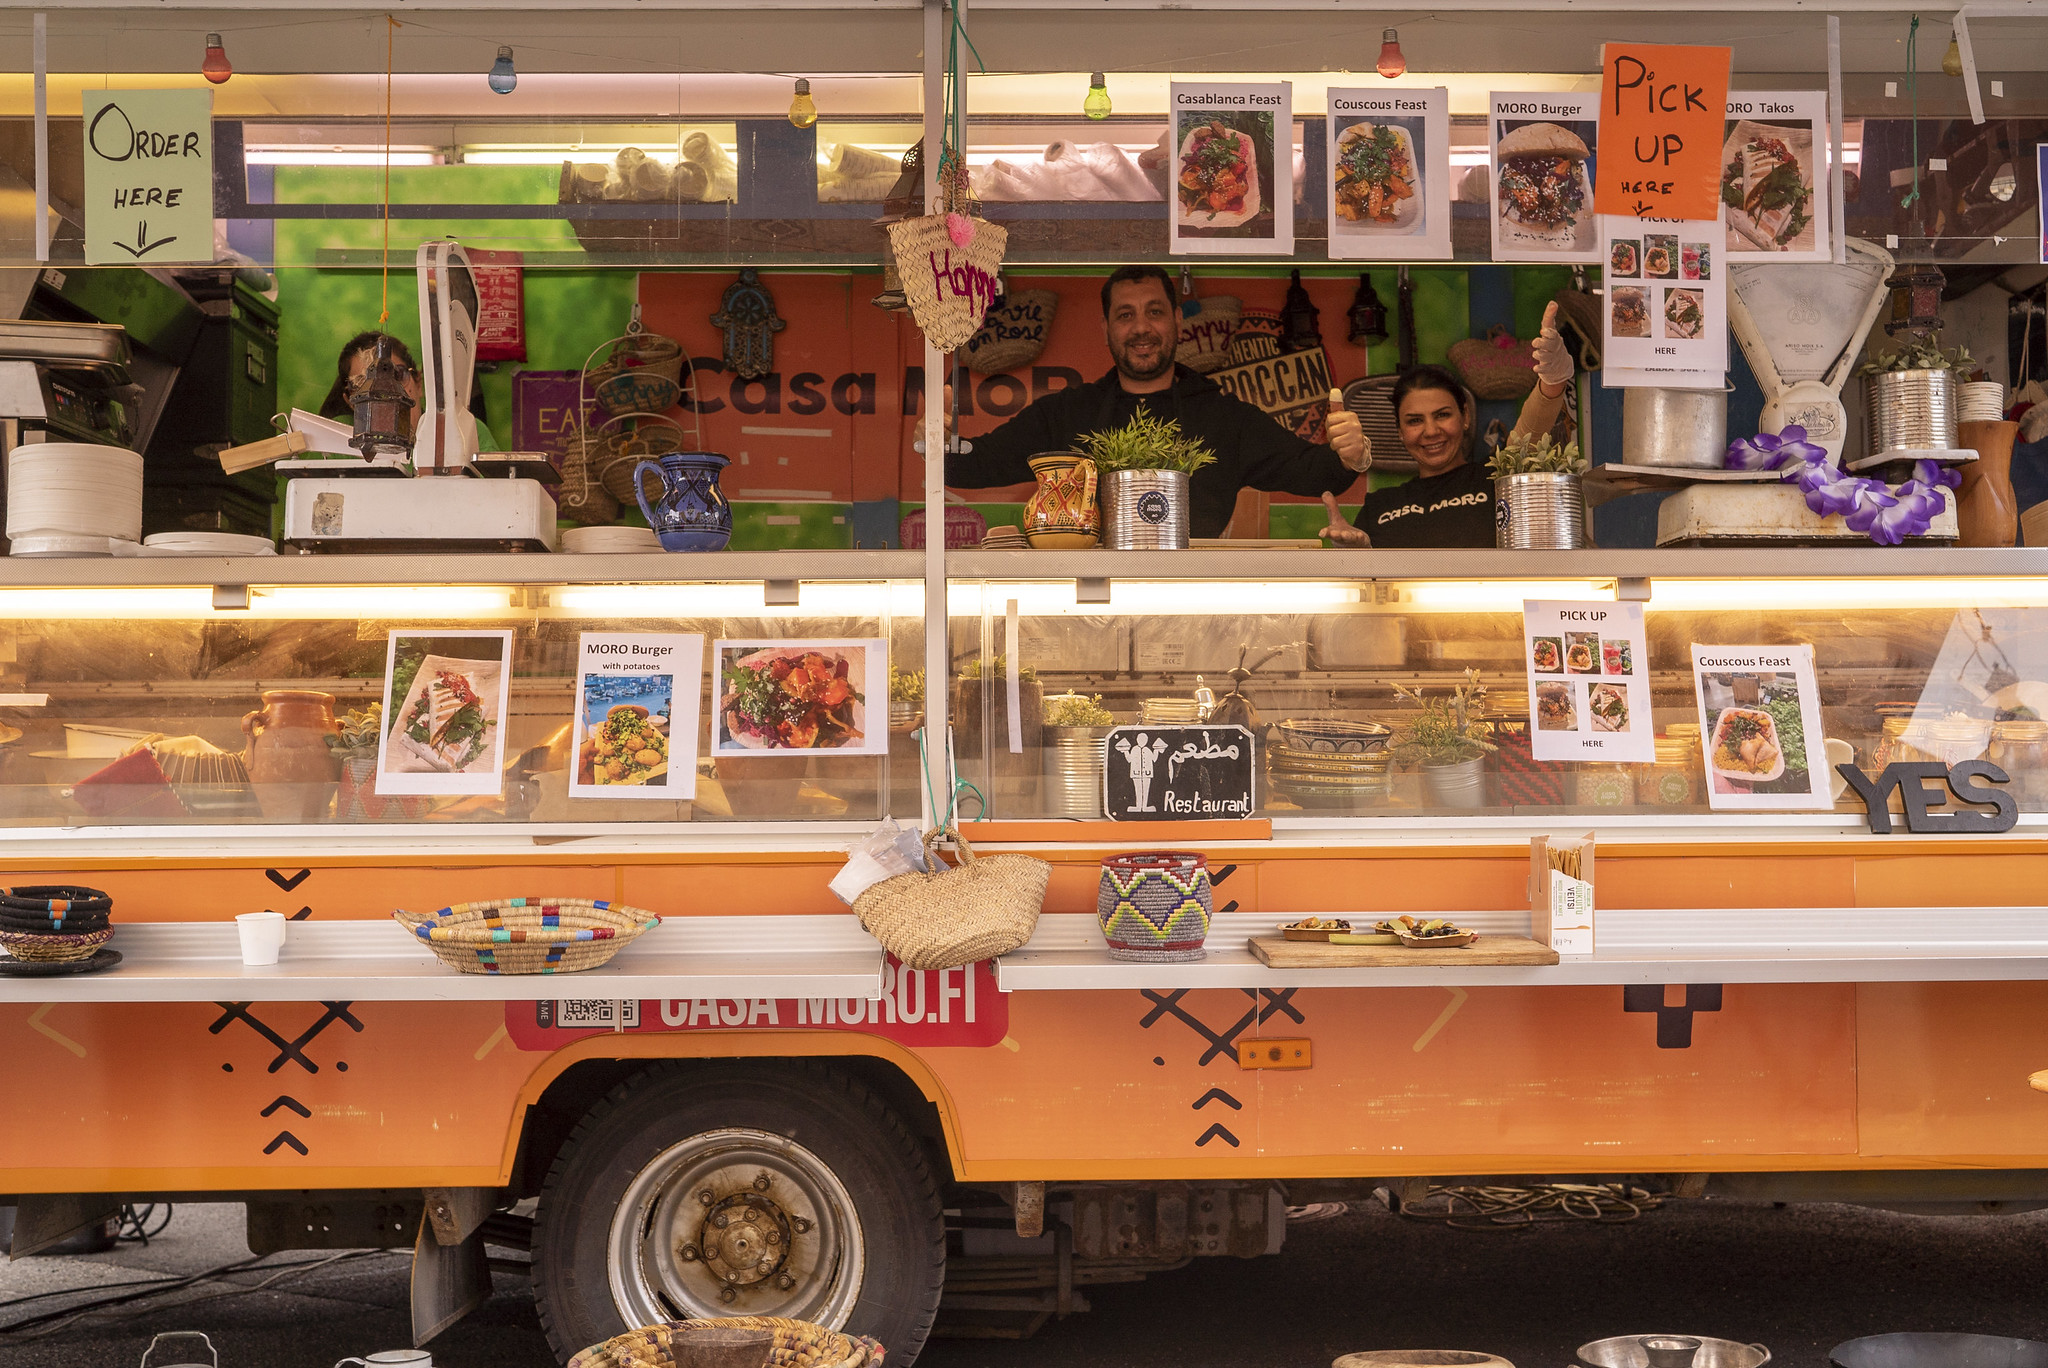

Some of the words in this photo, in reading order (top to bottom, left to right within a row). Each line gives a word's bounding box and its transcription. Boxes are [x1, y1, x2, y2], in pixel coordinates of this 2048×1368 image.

[1177, 93, 1246, 104] Casablanca
[1249, 94, 1282, 105] Feast
[1334, 99, 1392, 110] Couscous
[1395, 99, 1427, 110] Feast
[1725, 102, 1753, 113] ORO
[1759, 102, 1795, 113] Takos
[1497, 103, 1538, 114] MORO
[1541, 103, 1582, 117] Burger
[89, 103, 201, 161] ORDER
[1634, 133, 1684, 166] UP
[1621, 181, 1674, 194] HERE
[114, 187, 183, 209] HERE
[930, 249, 996, 319] Happy
[1001, 300, 1043, 322] vie
[996, 324, 1043, 342] Rose
[1177, 319, 1237, 354] appy
[1223, 336, 1281, 367] HENTIC
[1654, 347, 1677, 355] HERE
[680, 357, 877, 416] Casa
[1218, 352, 1331, 408] ROCCAN
[1560, 610, 1587, 621] PICK
[1590, 611, 1607, 621] UP
[587, 644, 629, 655] MORO
[632, 644, 674, 657] Burger
[602, 662, 621, 670] with
[623, 662, 661, 672] potatoes
[1699, 656, 1756, 667] Couscous
[1758, 656, 1791, 667] Feast
[1582, 740, 1604, 748] HERE
[1168, 731, 1240, 784] مطعم
[1164, 791, 1250, 813] Restaurant
[1835, 760, 2019, 834] YES
[1567, 887, 1575, 910] VEITSI
[541, 1007, 549, 1020] ME
